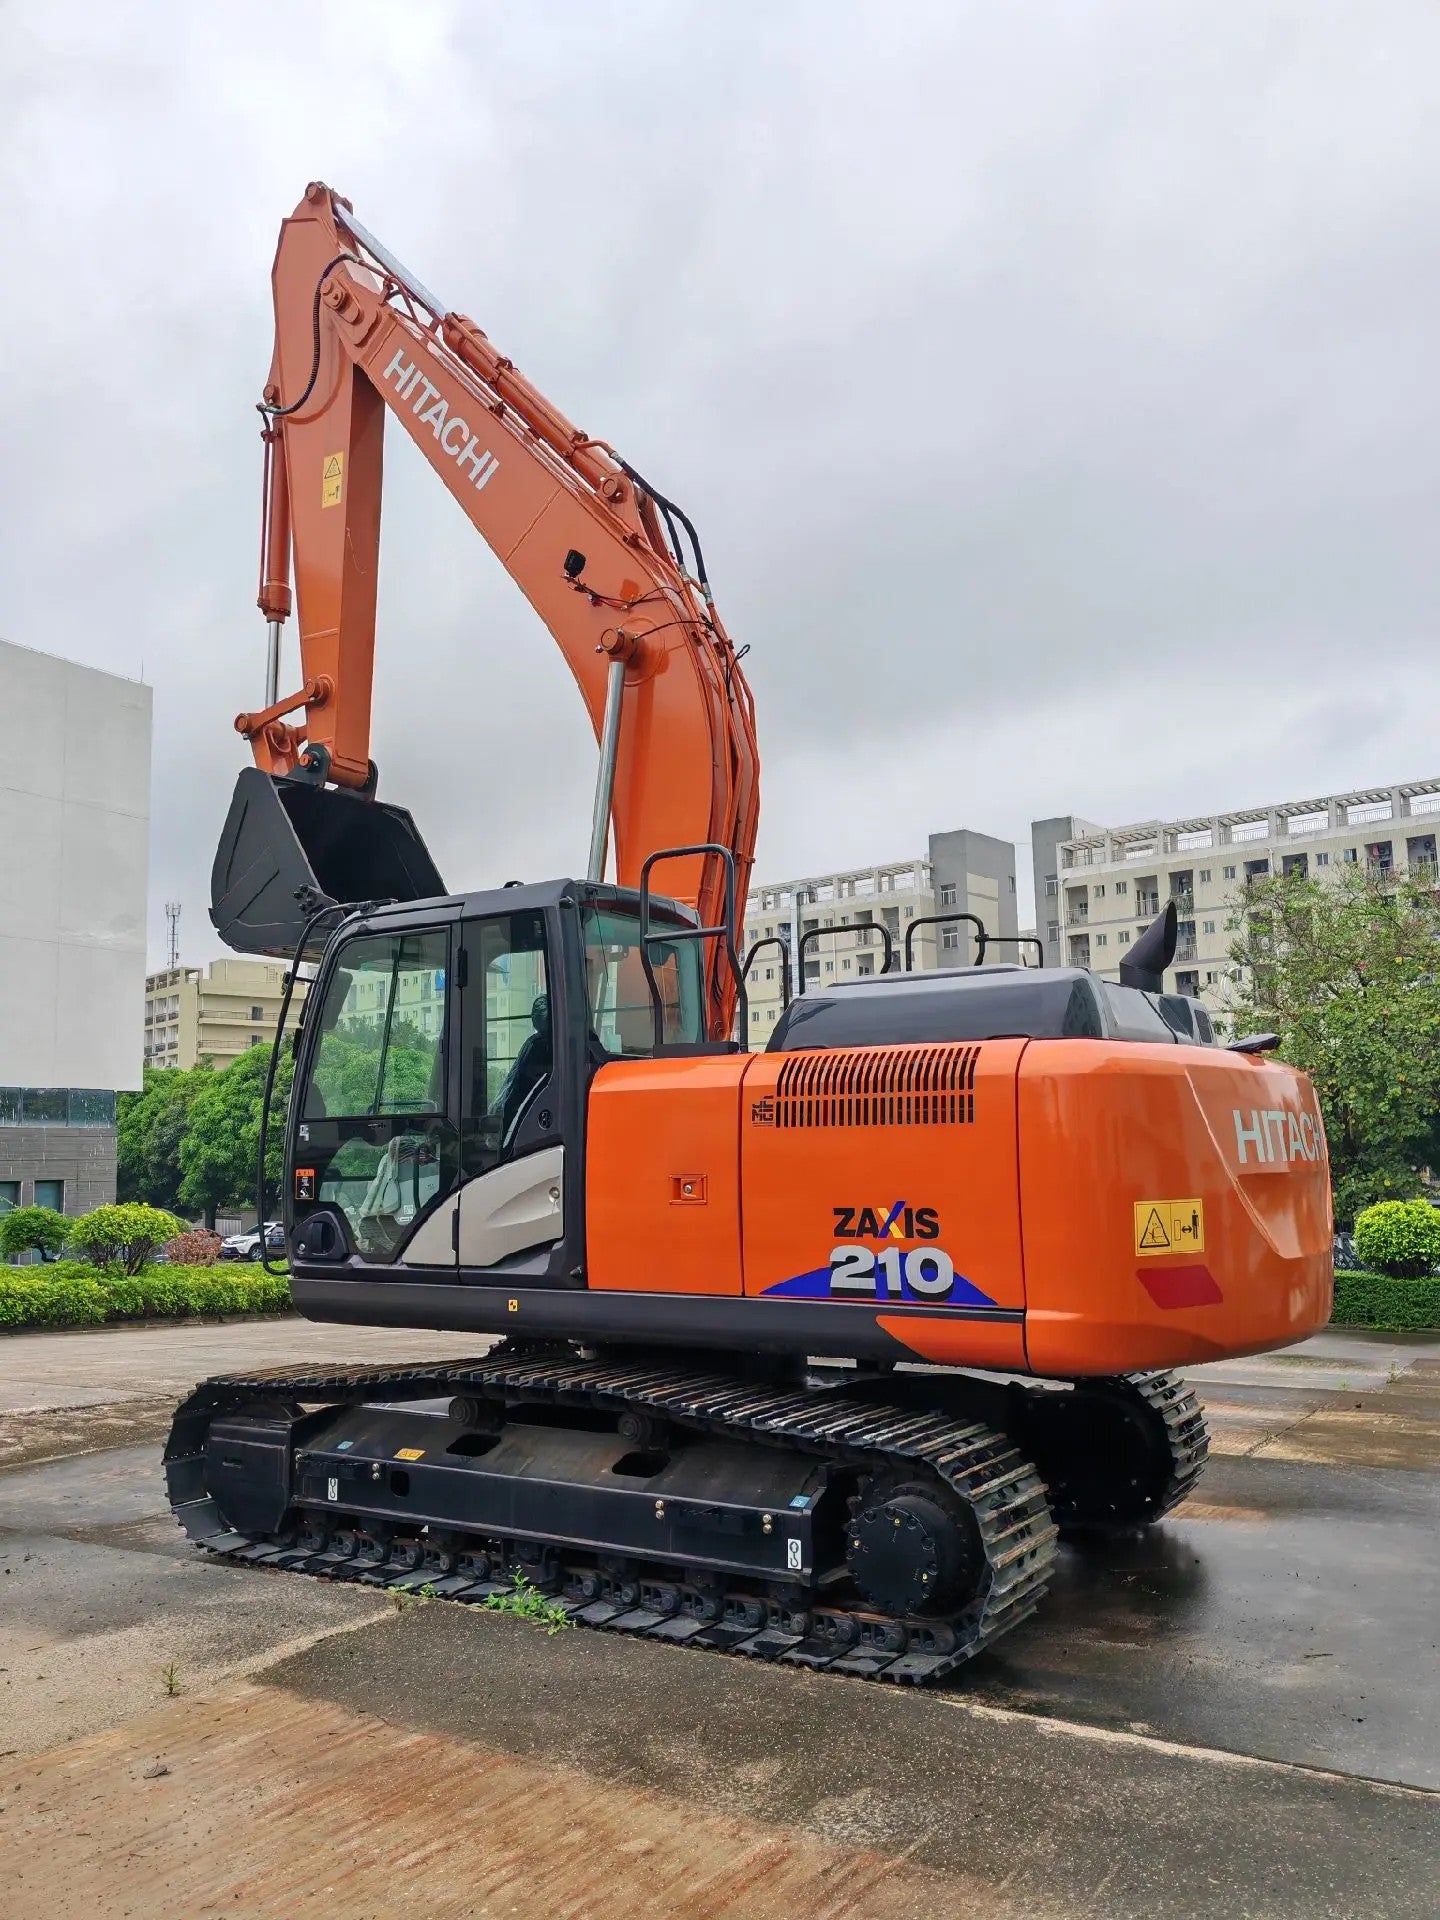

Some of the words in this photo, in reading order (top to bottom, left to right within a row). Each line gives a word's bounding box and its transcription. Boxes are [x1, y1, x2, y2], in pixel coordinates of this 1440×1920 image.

[382, 348, 500, 491] HITACHI
[1232, 1109, 1321, 1163] HITACH
[833, 1200, 940, 1239] ZAXIS
[829, 1244, 954, 1301] 210
